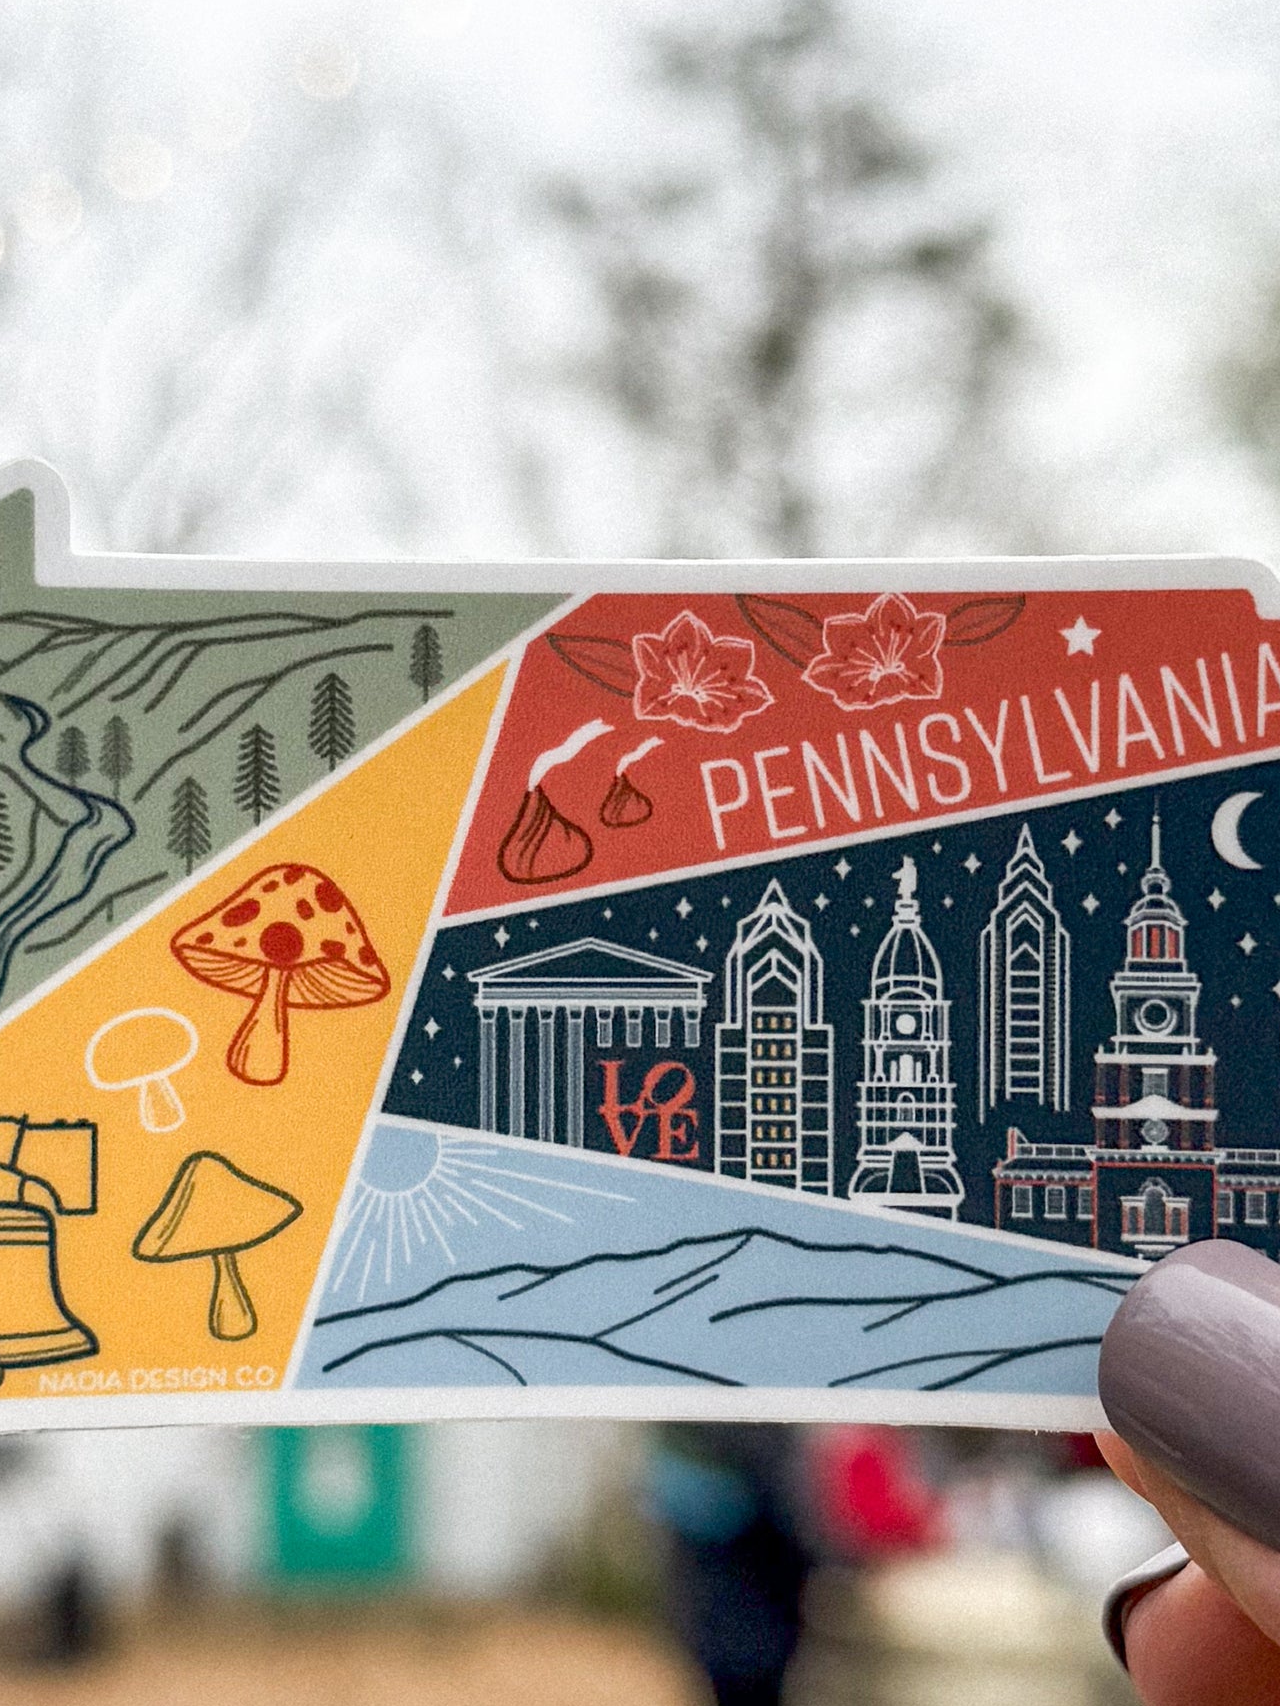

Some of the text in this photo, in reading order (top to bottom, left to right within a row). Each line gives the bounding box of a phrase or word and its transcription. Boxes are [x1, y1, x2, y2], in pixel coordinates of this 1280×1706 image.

[38, 1365, 276, 1393] NADIA DESIGN CO
